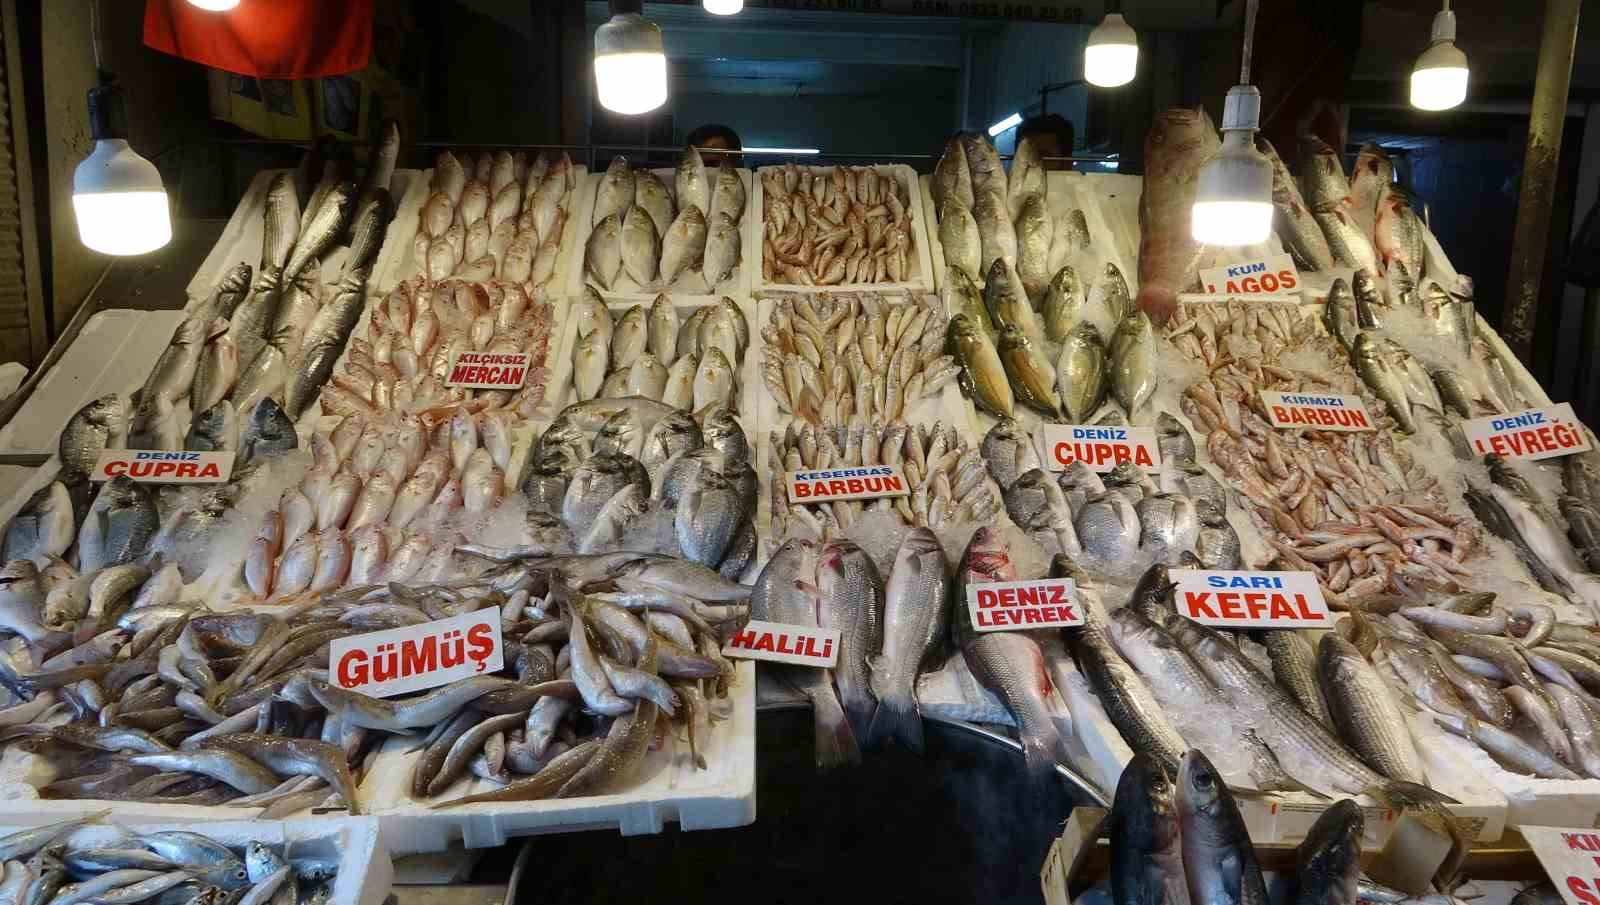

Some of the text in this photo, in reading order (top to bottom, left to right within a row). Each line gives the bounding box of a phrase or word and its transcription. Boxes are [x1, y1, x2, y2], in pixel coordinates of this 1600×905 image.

[1228, 263, 1266, 277] KUM
[457, 353, 526, 366] KILÇIKSIZ
[449, 366, 524, 385] MERCAN
[1281, 396, 1343, 406] KIRMIZI
[1272, 406, 1368, 427] BARBUN
[795, 467, 893, 480] KESERBAŞ
[794, 477, 902, 498] BARBUN
[1207, 575, 1282, 588] SARI
[1185, 592, 1324, 620] KEFAL
[976, 606, 1080, 627] LEVREK
